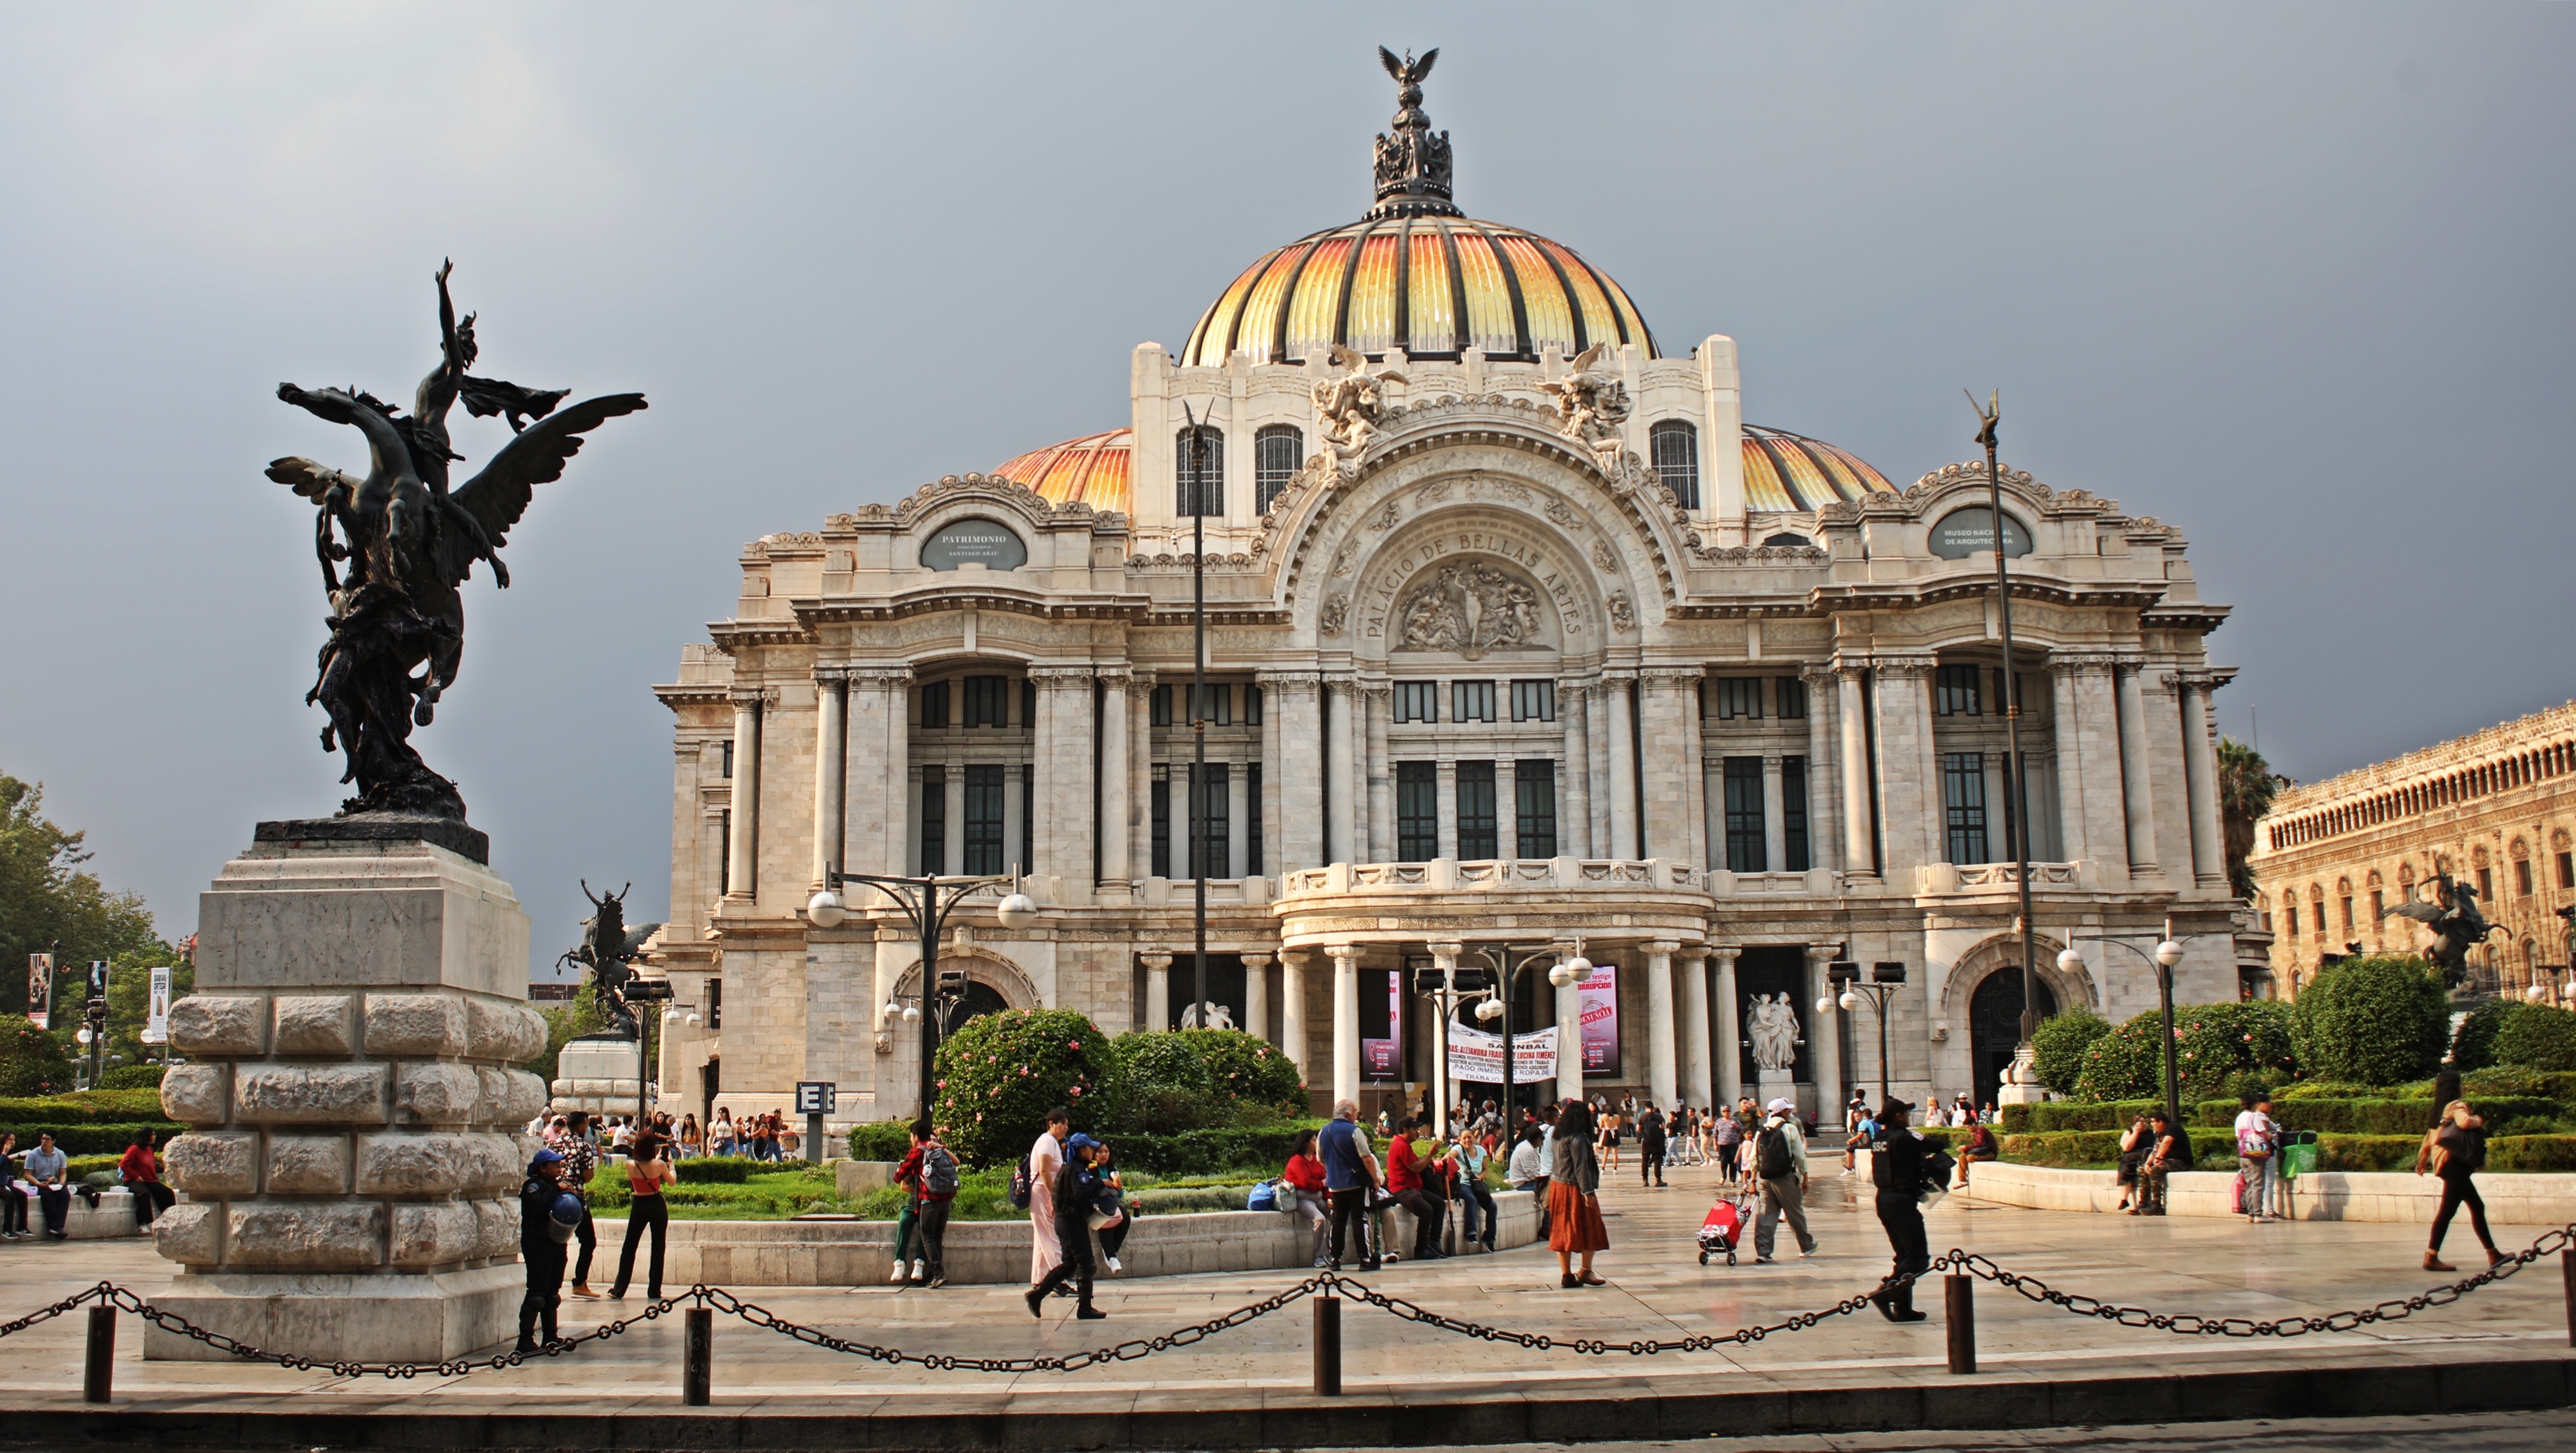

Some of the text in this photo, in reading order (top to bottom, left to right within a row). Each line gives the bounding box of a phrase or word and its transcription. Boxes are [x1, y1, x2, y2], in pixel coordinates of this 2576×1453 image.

[1367, 534, 1581, 638] PALACIO DE BELLAS ARTES
[1578, 982, 1612, 991] ORRUPCIÓN
[1460, 1047, 1487, 1057] ALEJANDRA
[1465, 1074, 1500, 1083] TRABAJO
[801, 1086, 820, 1110] E
[828, 1086, 834, 1110] E
[1872, 1141, 1888, 1152] SSC
